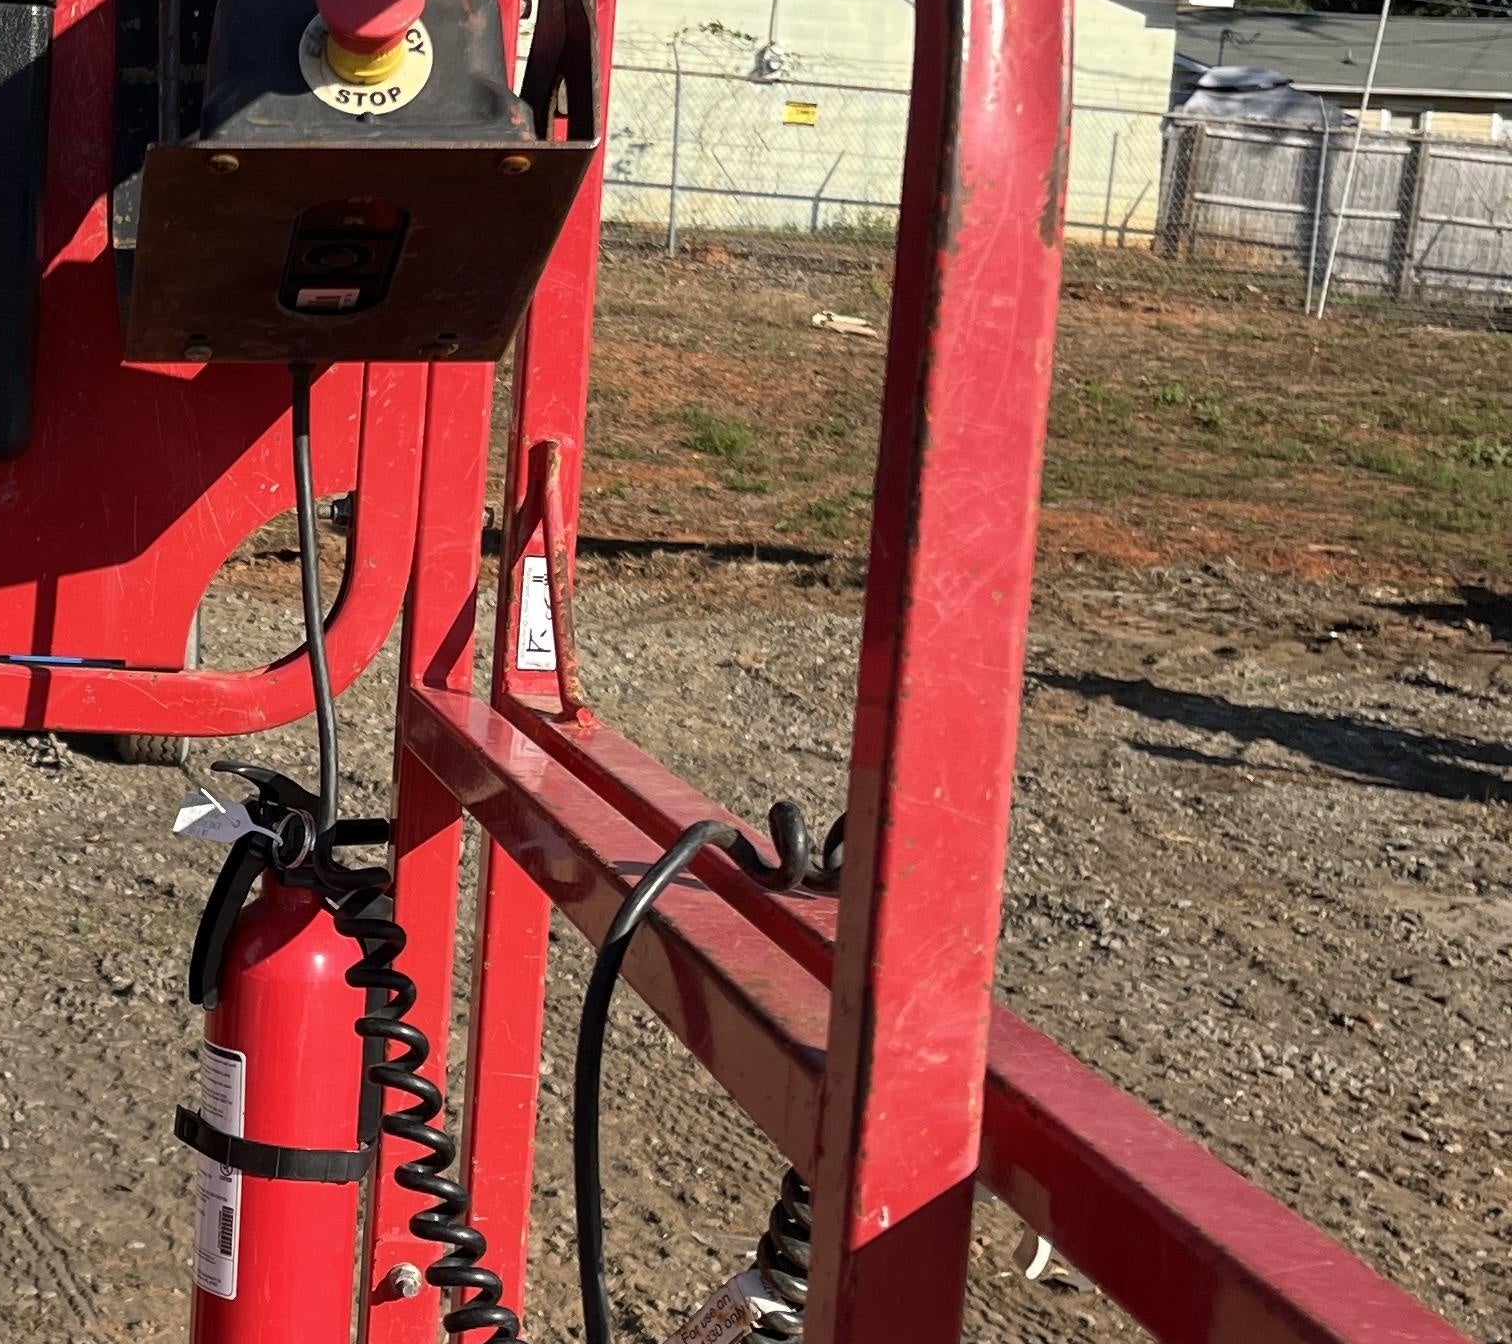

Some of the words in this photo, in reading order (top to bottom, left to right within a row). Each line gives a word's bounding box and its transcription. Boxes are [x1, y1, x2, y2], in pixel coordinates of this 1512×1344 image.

[335, 86, 401, 107] STOP
[700, 1309, 718, 1330] use
[724, 1305, 747, 1328] only
